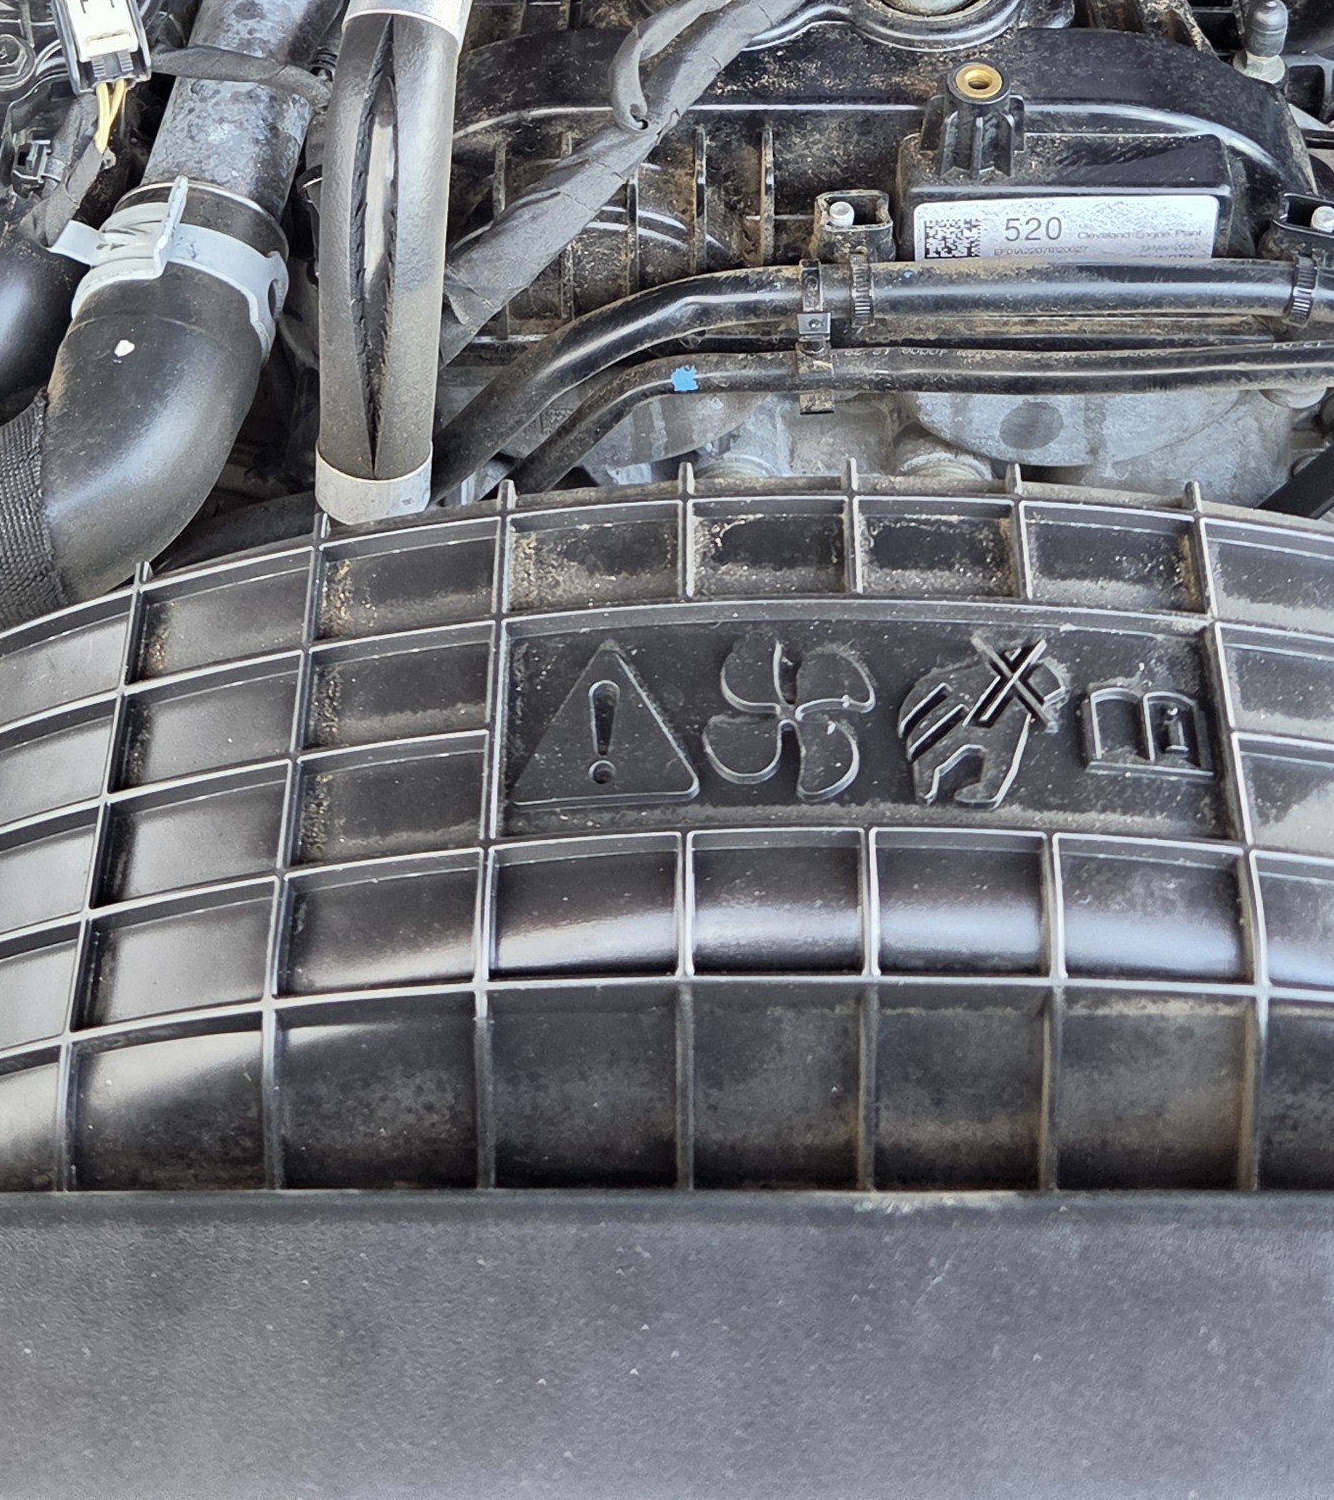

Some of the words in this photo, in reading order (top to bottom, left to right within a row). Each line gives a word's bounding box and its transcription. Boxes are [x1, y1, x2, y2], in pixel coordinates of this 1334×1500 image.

[1004, 216, 1063, 242] 520
[1077, 229, 1131, 241] Cleveland
[1174, 228, 1202, 239] Plant
